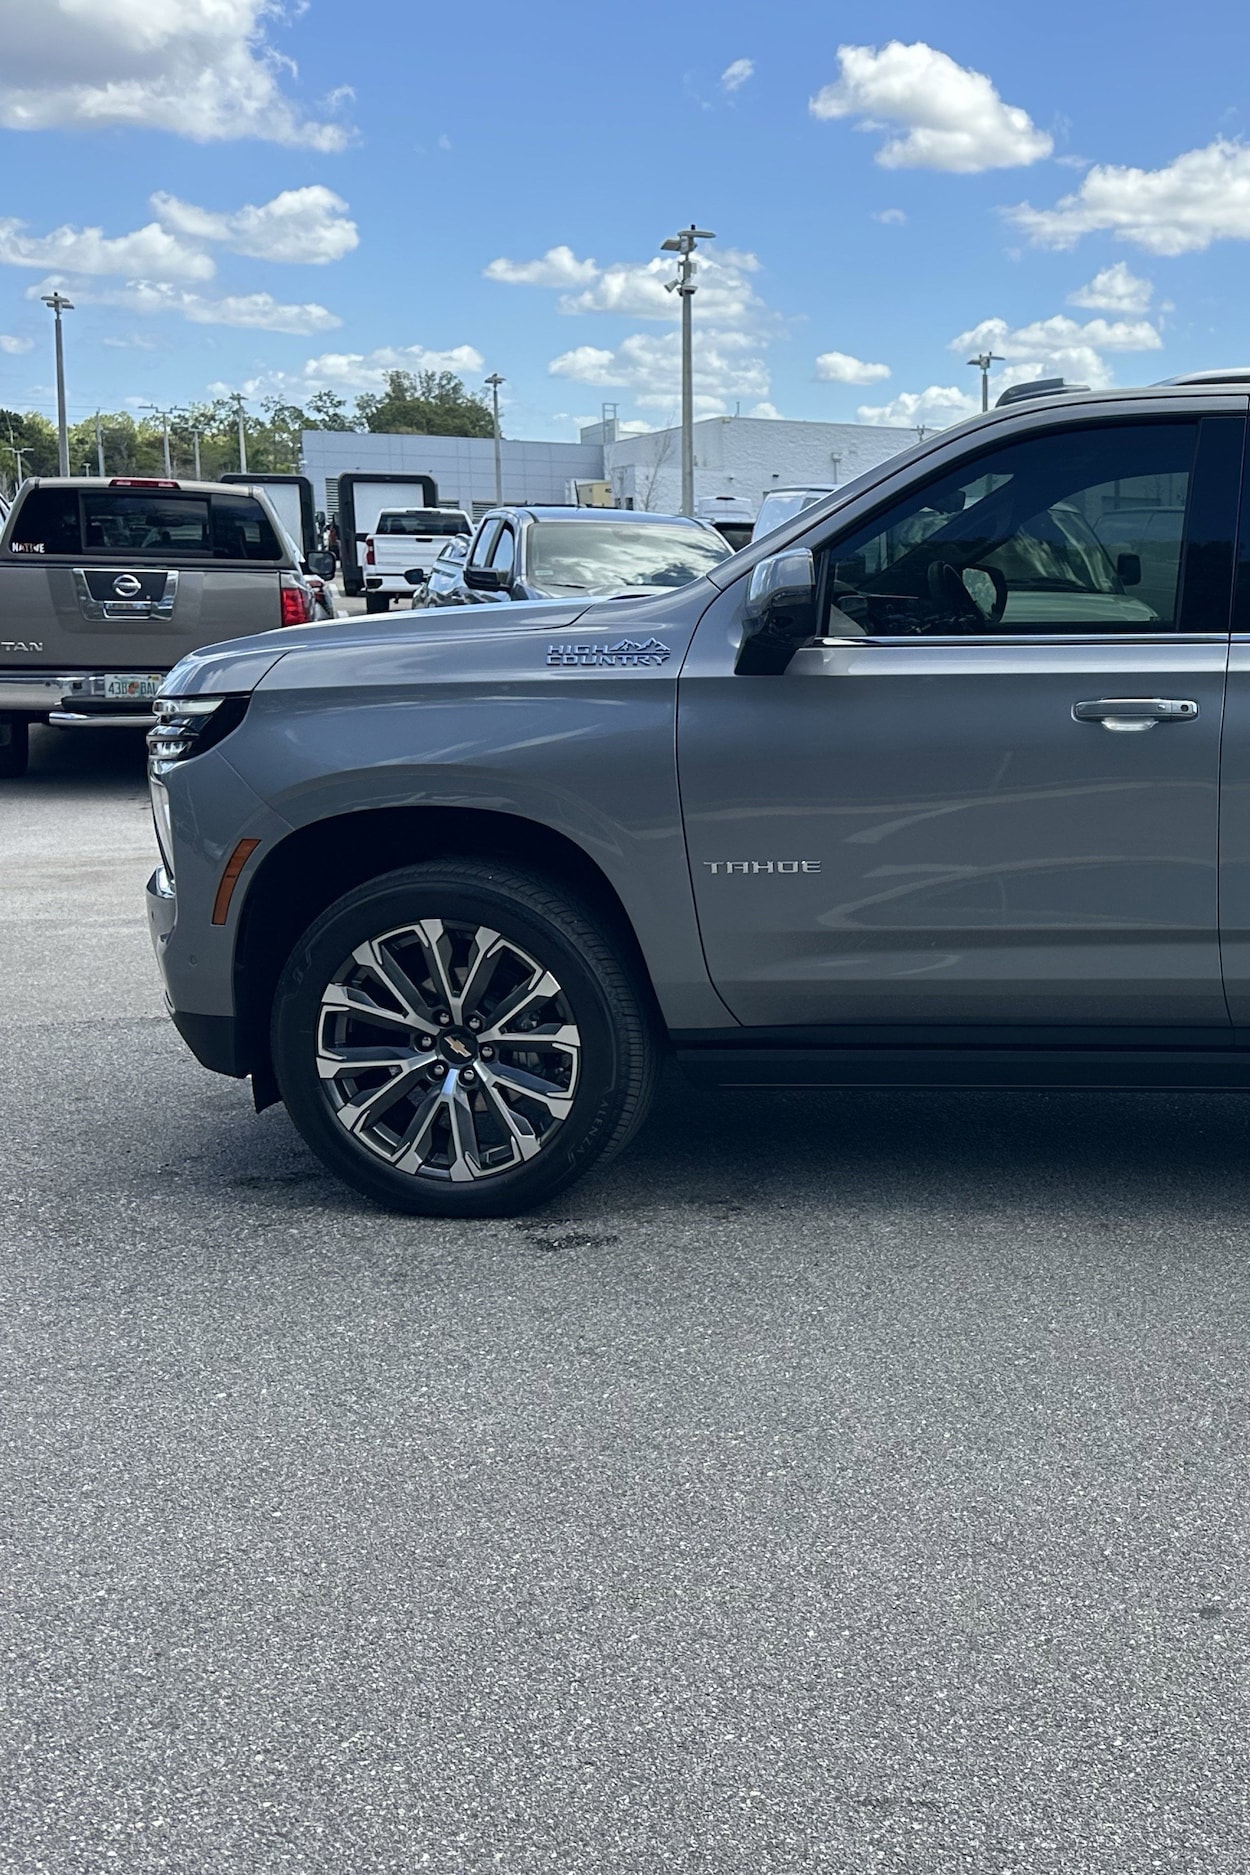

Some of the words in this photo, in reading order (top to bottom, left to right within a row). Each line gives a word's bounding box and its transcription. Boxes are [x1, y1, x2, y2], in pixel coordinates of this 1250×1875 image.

[12, 542, 45, 553] NATIVE
[547, 644, 609, 655] HIGH
[546, 655, 670, 666] COUNTRY
[703, 860, 822, 875] TAHOE
